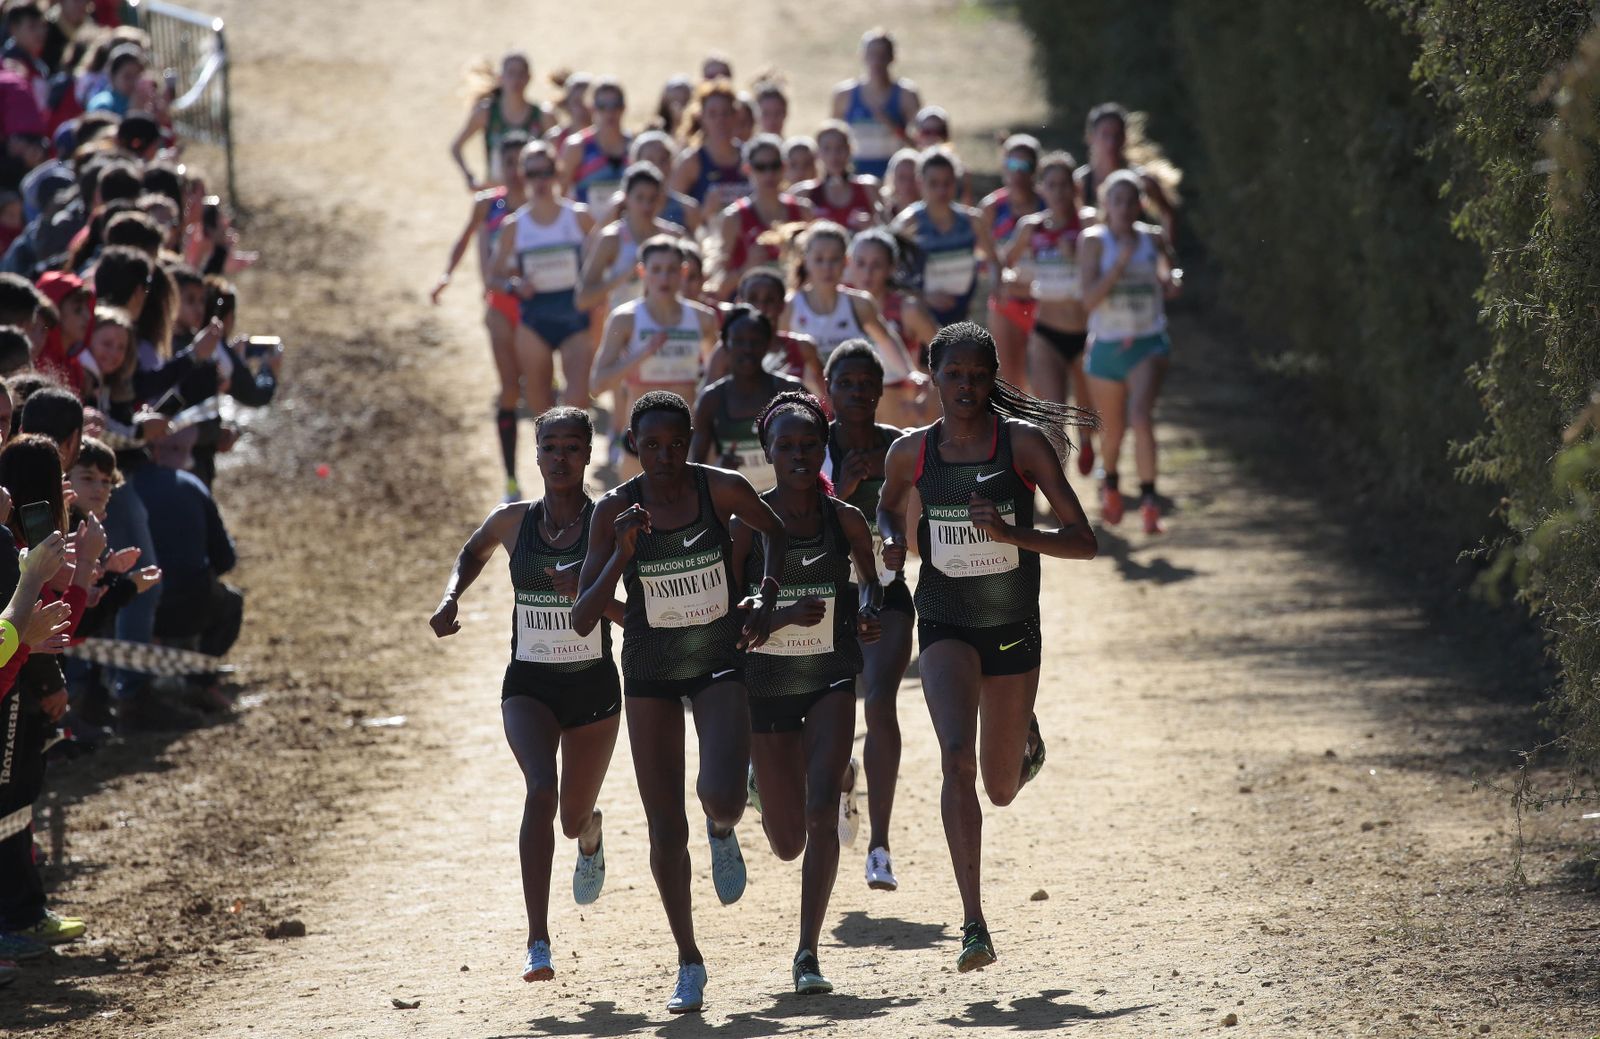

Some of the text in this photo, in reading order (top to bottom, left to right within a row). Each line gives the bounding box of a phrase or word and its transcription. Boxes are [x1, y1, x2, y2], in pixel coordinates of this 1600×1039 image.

[641, 551, 720, 573] DIPUTACION DE SEVILLA
[970, 556, 1008, 567] ITÁLICA
[646, 567, 721, 598] YASMINE CAN
[518, 593, 557, 603] DIPUTACION
[797, 588, 806, 597] DE
[808, 586, 833, 595] SEVILLA
[685, 603, 720, 618] ITÁLICA
[525, 610, 572, 630] ALEMAY
[553, 644, 590, 654] ITÁLICA
[787, 638, 822, 647] ITÁLICA
[0, 692, 20, 784] TROTASIERRA
